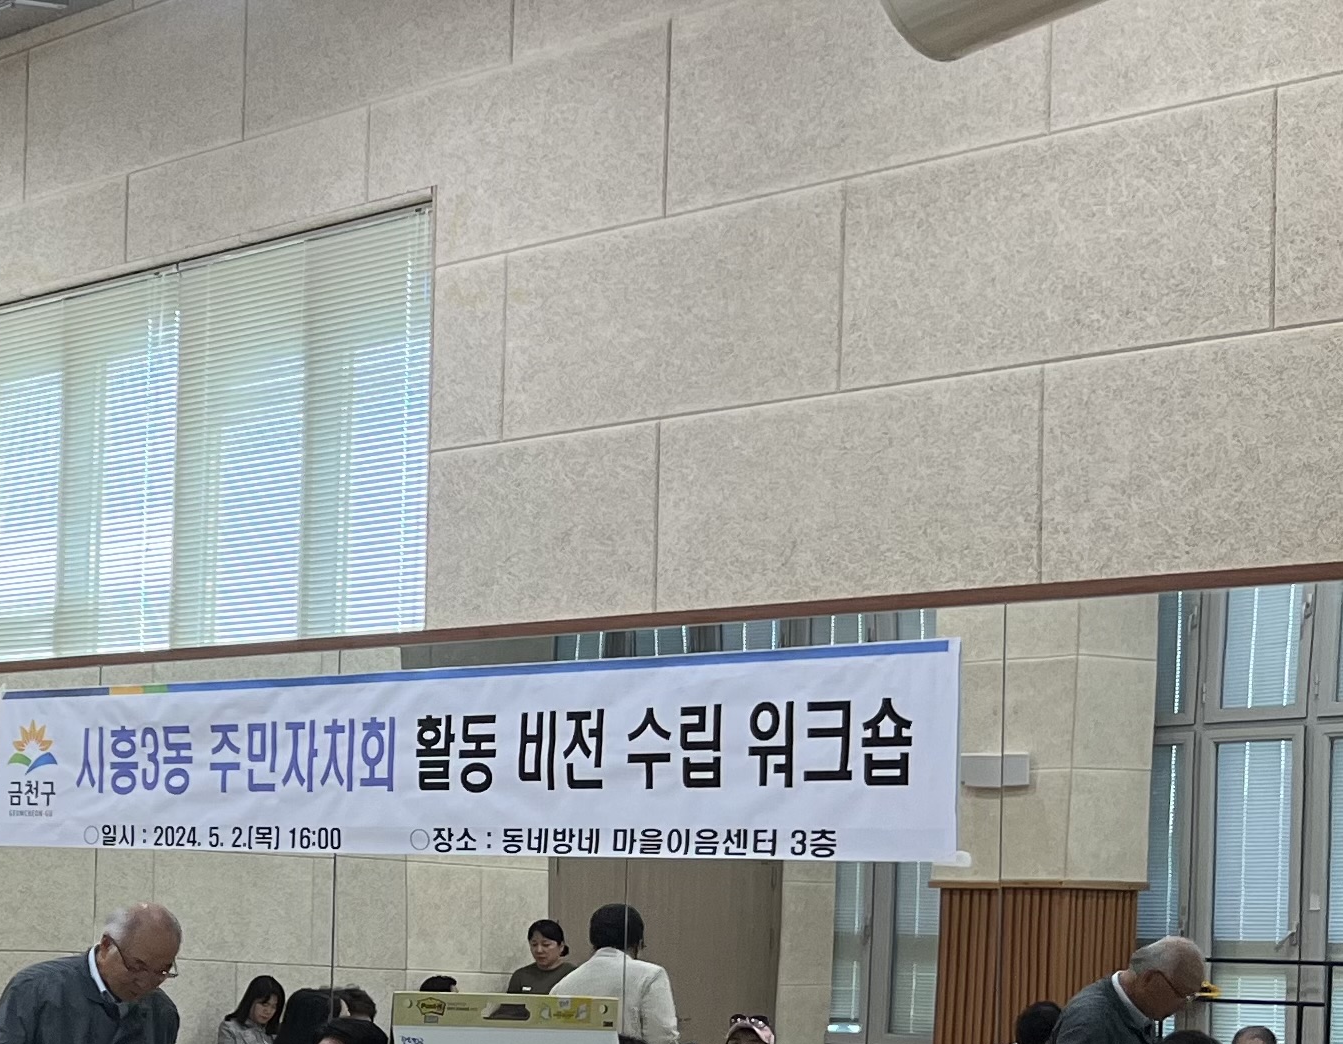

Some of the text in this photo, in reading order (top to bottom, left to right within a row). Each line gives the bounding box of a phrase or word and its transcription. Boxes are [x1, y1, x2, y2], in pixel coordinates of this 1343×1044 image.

[76, 697, 913, 795] 시흥3동 주민자치회 활동 비전 수립 워크숍
[7, 780, 56, 807] 금천구
[101, 824, 135, 847] 일시
[153, 826, 202, 847] 2024.
[208, 826, 224, 848] 5.
[288, 827, 342, 850] 16:00
[432, 827, 477, 853] 장소
[502, 827, 601, 854] 동네방네
[612, 827, 778, 856] 마을이음센터
[790, 829, 837, 858] 3층
